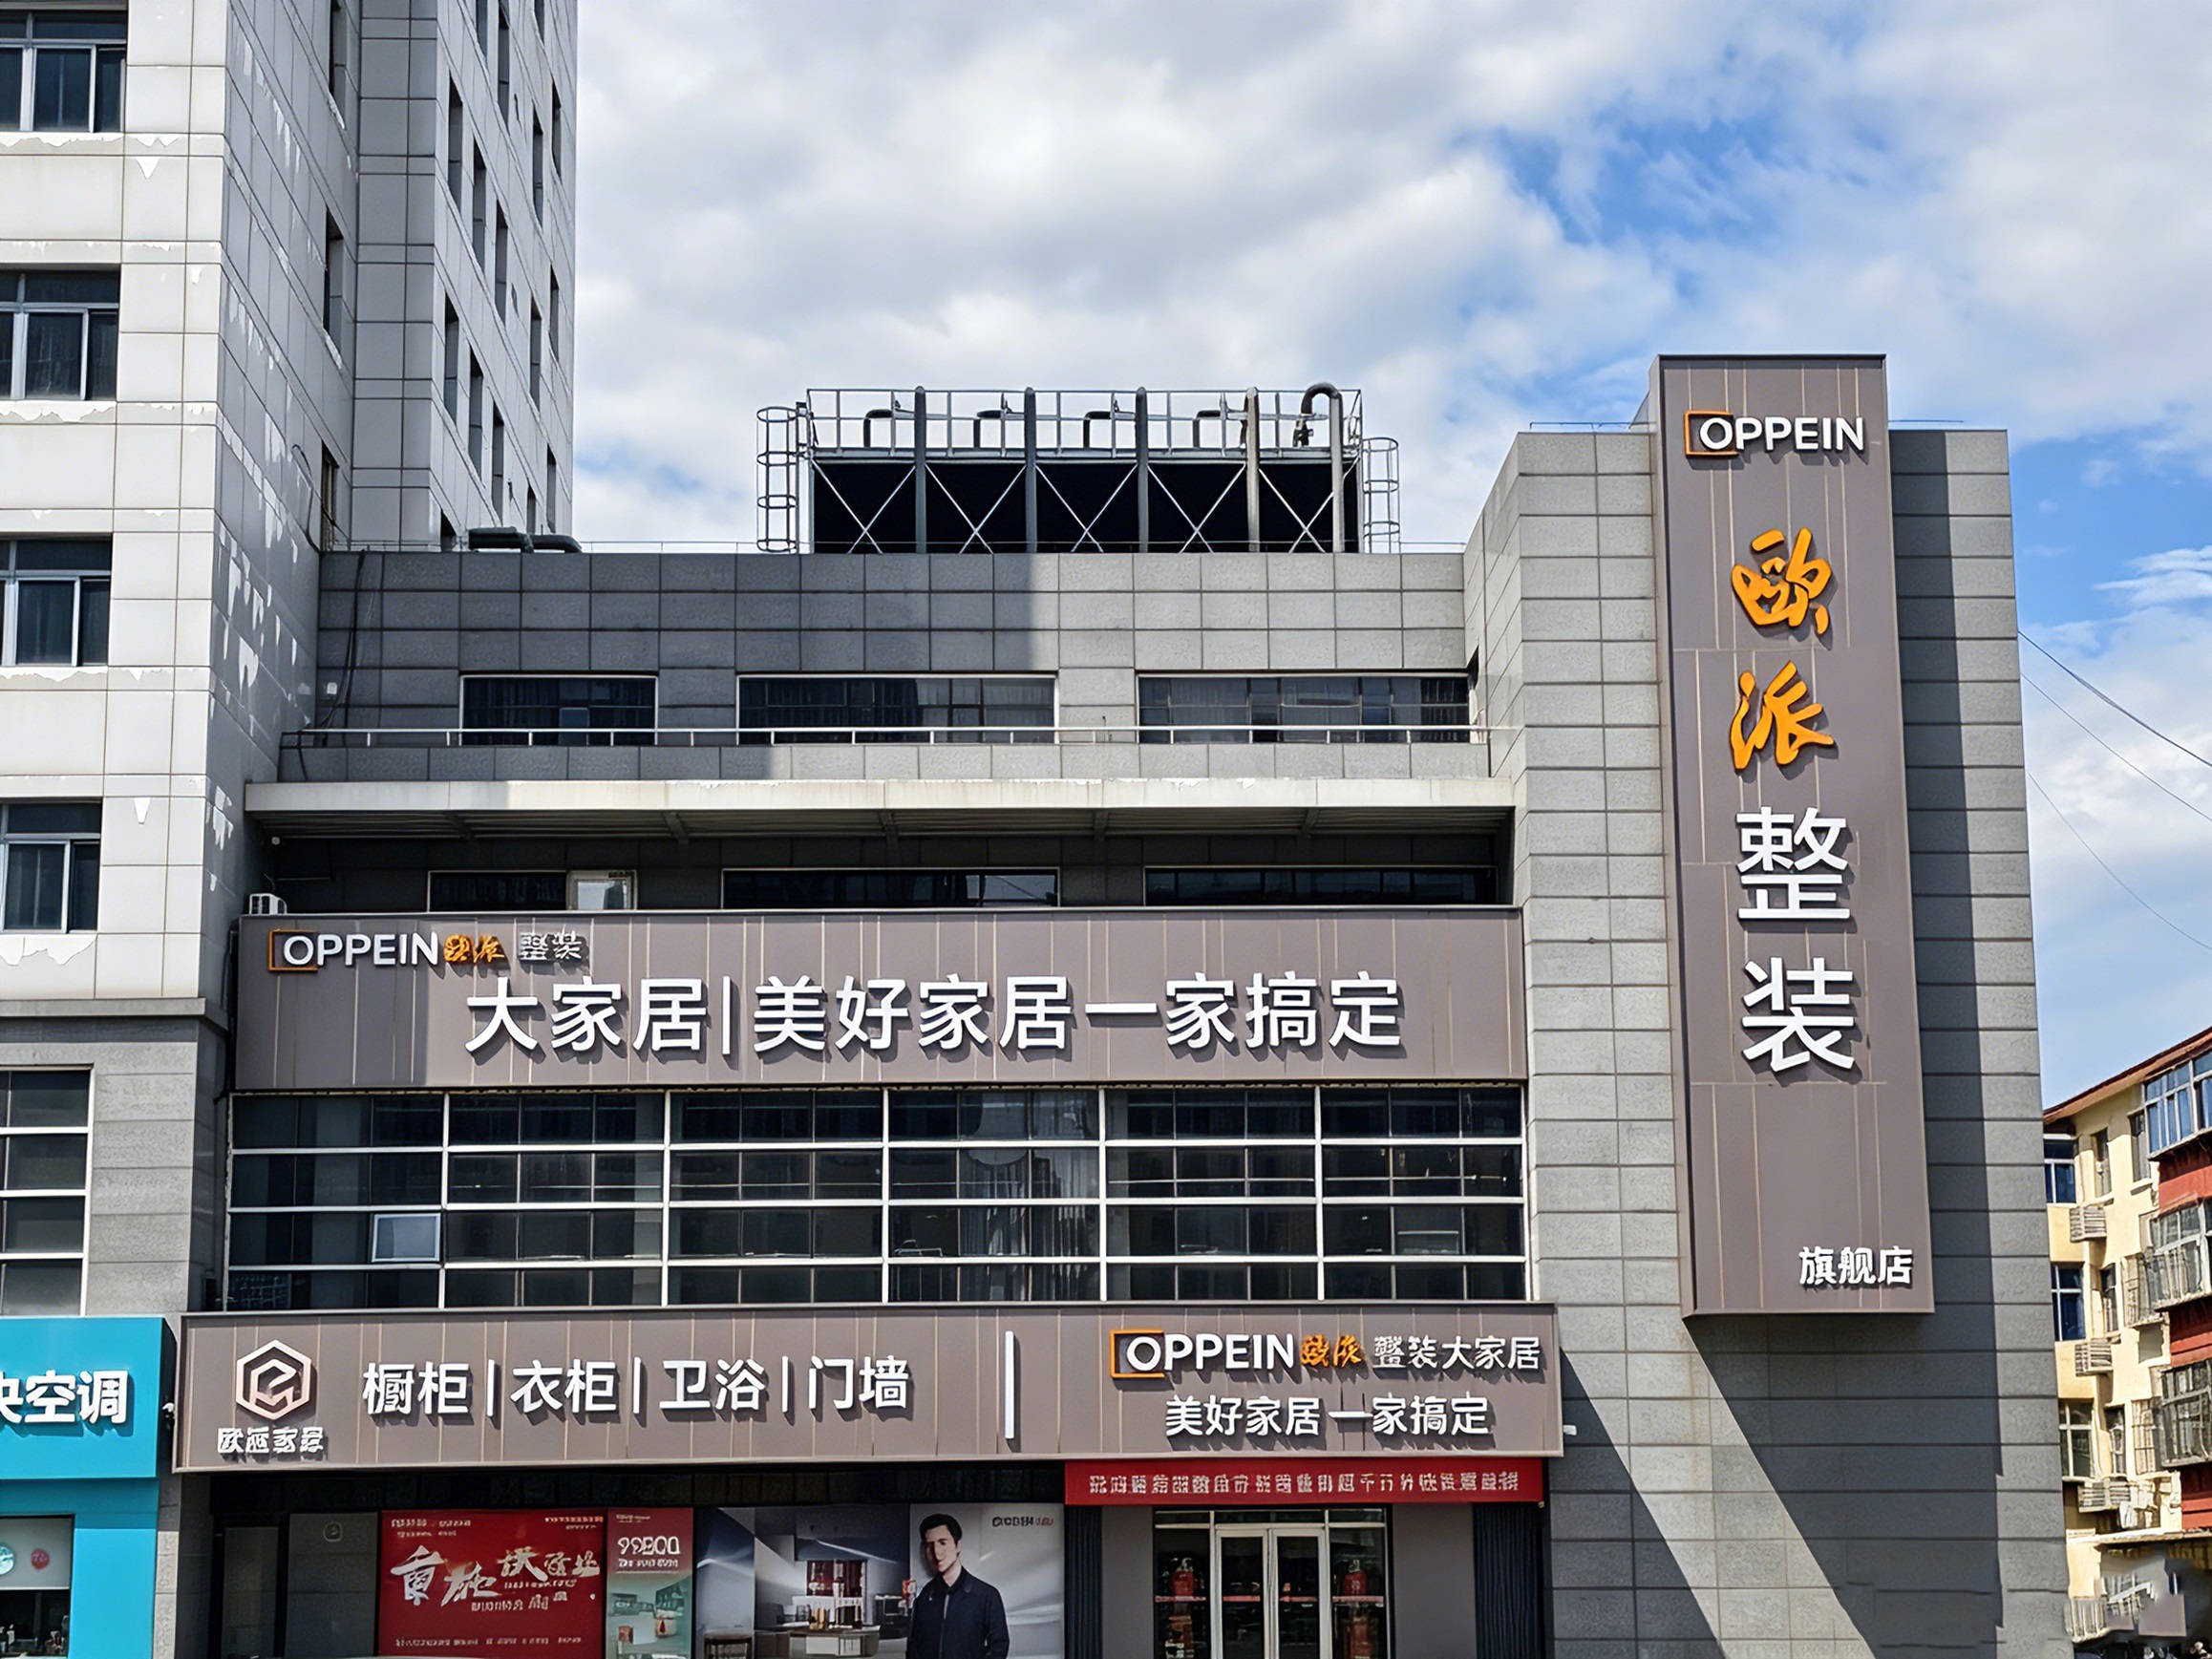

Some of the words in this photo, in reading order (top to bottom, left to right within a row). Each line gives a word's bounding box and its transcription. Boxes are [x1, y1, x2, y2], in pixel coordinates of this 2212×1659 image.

[1698, 415, 1865, 452] OPPEIN
[283, 932, 439, 967] OPPEIN
[1735, 805, 1855, 1073] 整装
[463, 976, 709, 1053] 大家居
[753, 970, 1401, 1053] 美好家居一家搞定
[1797, 1244, 1914, 1286] 旗舰店
[1125, 1332, 1295, 1372] OPPEIN
[361, 1360, 470, 1416] 橱柜
[509, 1357, 617, 1414] 衣柜
[658, 1357, 766, 1413] 卫浴
[807, 1353, 910, 1412] 门墙
[1164, 1392, 1490, 1436] 美好家居一家搞定
